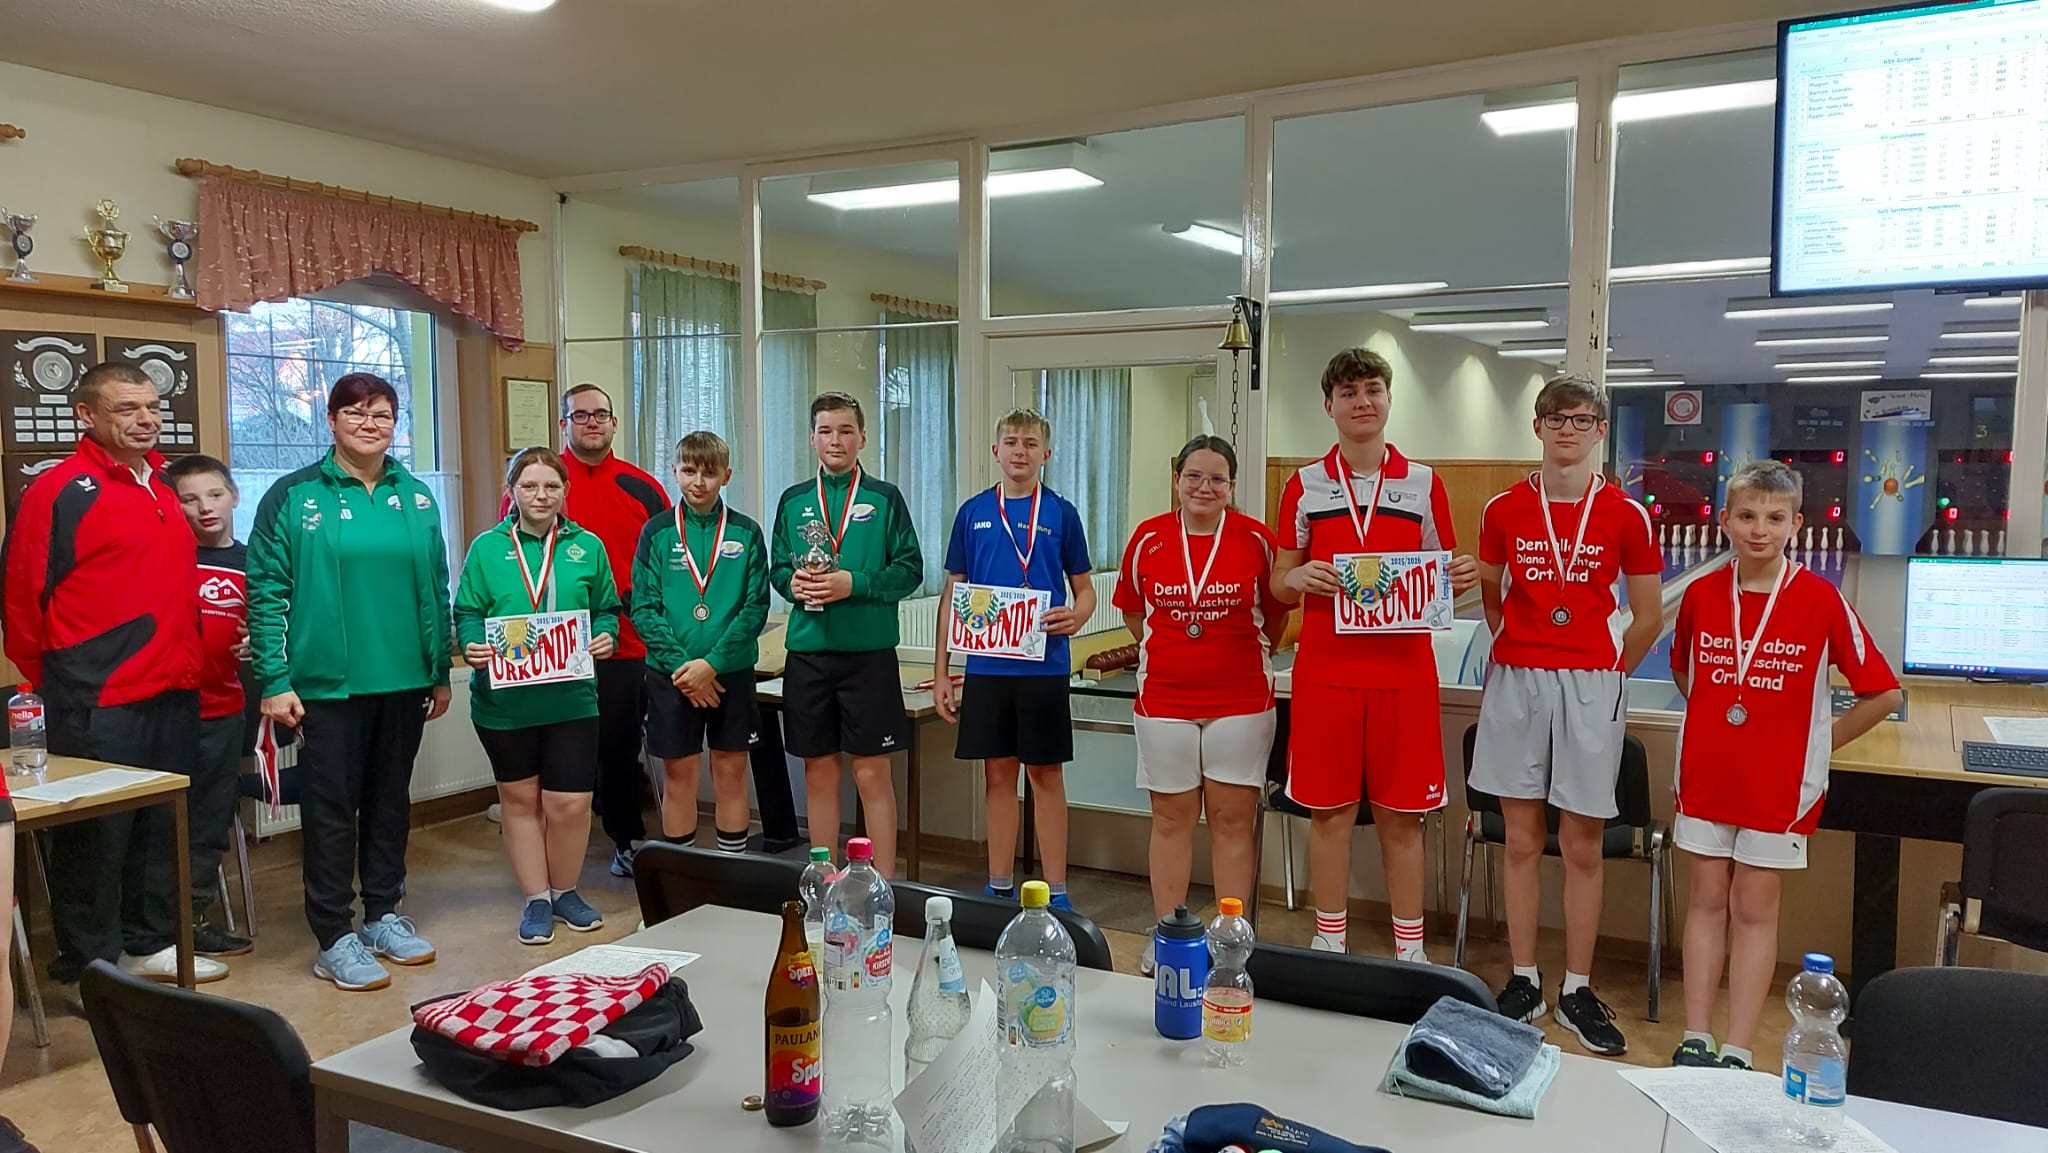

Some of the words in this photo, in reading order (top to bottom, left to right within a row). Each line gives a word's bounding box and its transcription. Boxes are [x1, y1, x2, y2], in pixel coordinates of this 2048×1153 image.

[1679, 429, 1685, 441] 1
[1806, 427, 1816, 440] 2
[1976, 425, 1988, 438] 3
[973, 520, 992, 530] JAKO
[1516, 554, 1545, 565] Diana
[1360, 587, 1376, 604] 2
[1155, 598, 1185, 608] Diana
[971, 615, 984, 629] 3
[511, 645, 523, 660] 1
[1699, 651, 1734, 665] Diana
[11, 710, 34, 720] hella
